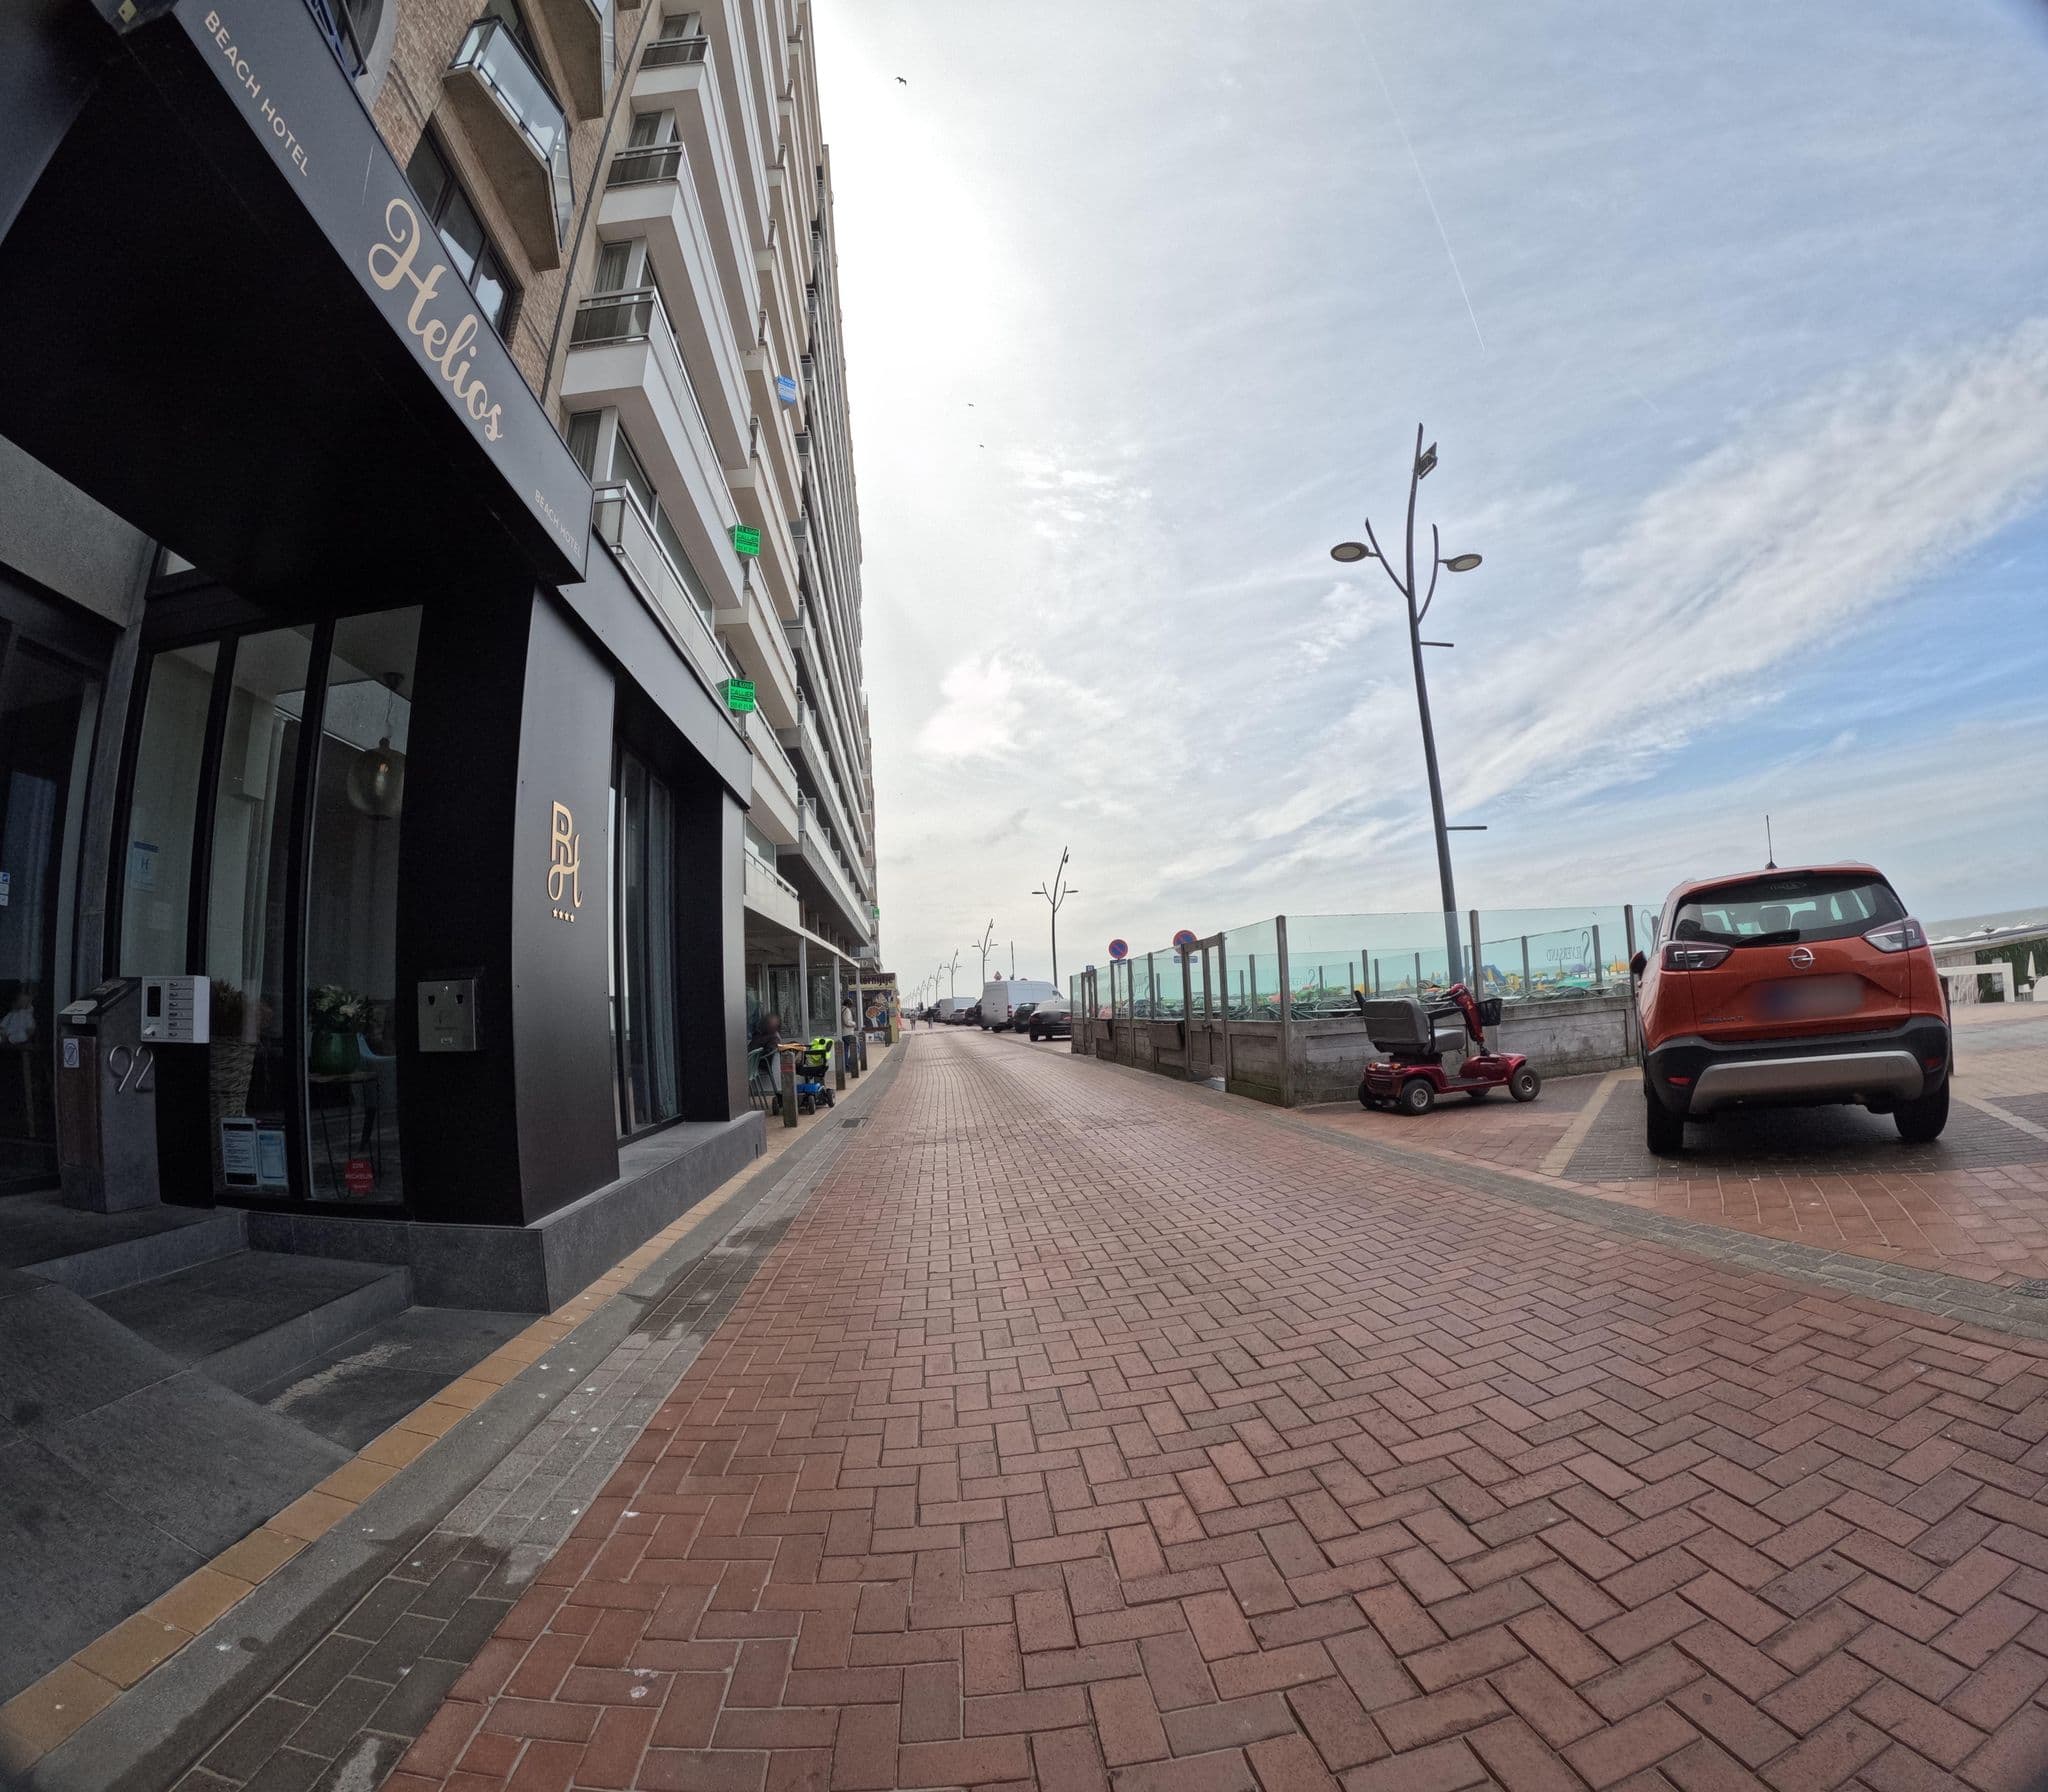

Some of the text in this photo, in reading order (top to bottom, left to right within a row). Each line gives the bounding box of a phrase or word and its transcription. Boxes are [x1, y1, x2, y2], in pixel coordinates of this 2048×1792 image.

[204, 10, 309, 177] BEACH HOTEL
[368, 198, 503, 442] Helios
[535, 488, 582, 559] BEACH HOTEL
[109, 1044, 154, 1093] 92
